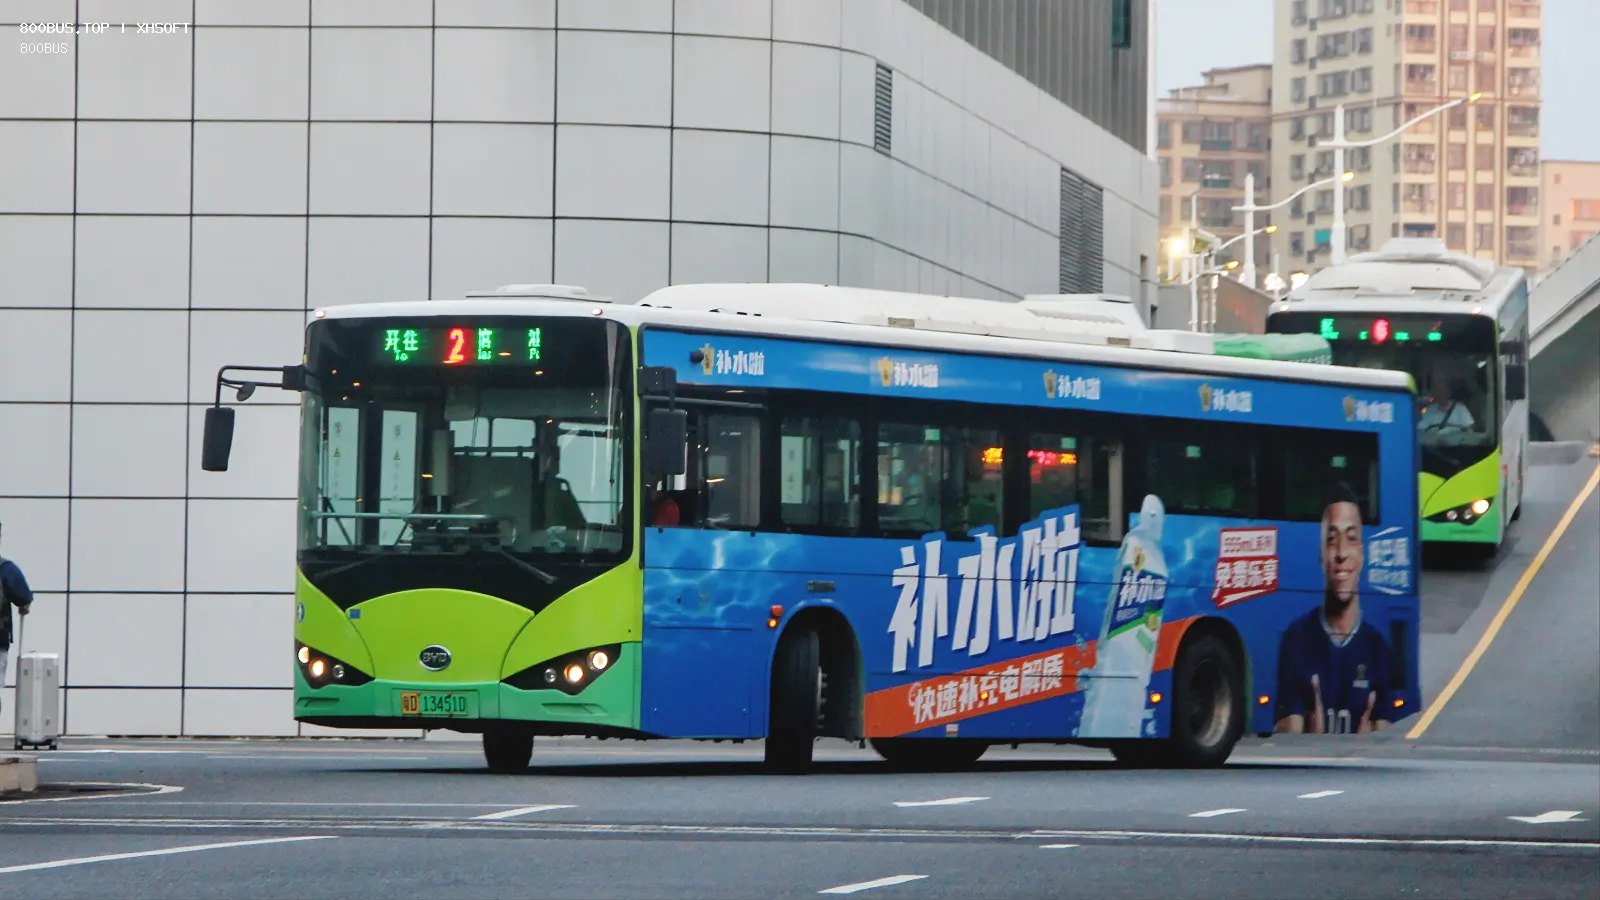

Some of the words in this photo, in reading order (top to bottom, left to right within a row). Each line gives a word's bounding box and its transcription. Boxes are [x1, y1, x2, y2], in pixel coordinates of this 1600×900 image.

[384, 329, 419, 351] 开往
[449, 328, 465, 361] 2
[716, 349, 765, 376] 补水啦
[887, 512, 1081, 673] 补水啦
[422, 652, 448, 663] BYD
[913, 652, 1065, 725] 快速补充电解质
